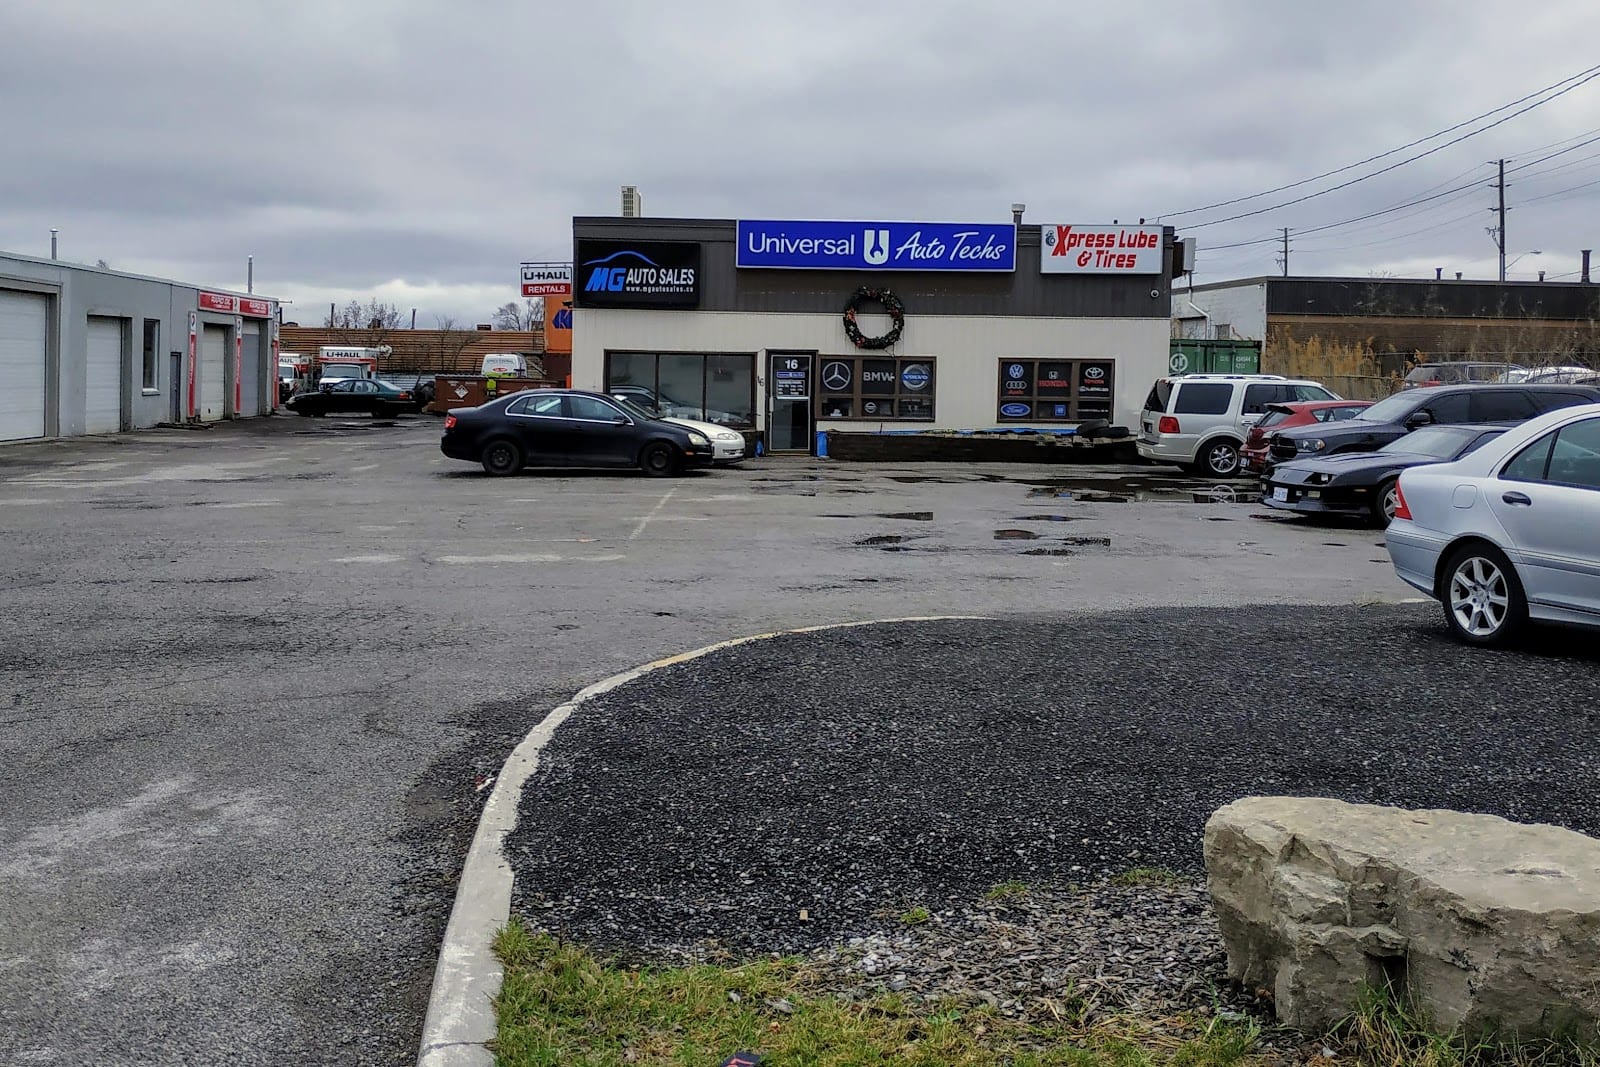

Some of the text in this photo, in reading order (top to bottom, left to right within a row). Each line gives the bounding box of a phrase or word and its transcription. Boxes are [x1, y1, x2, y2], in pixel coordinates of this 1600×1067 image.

[748, 232, 855, 256] Universal
[894, 231, 1006, 262] Auto Techs
[1051, 225, 1158, 257] Xpress Lube
[1077, 250, 1137, 268] & Tires
[523, 271, 570, 281] U-HAUL
[584, 267, 626, 292] MG
[626, 268, 695, 285] AUTO SALES
[527, 285, 566, 294] RENTALS
[785, 359, 799, 370] 16
[863, 372, 893, 382] BMW
